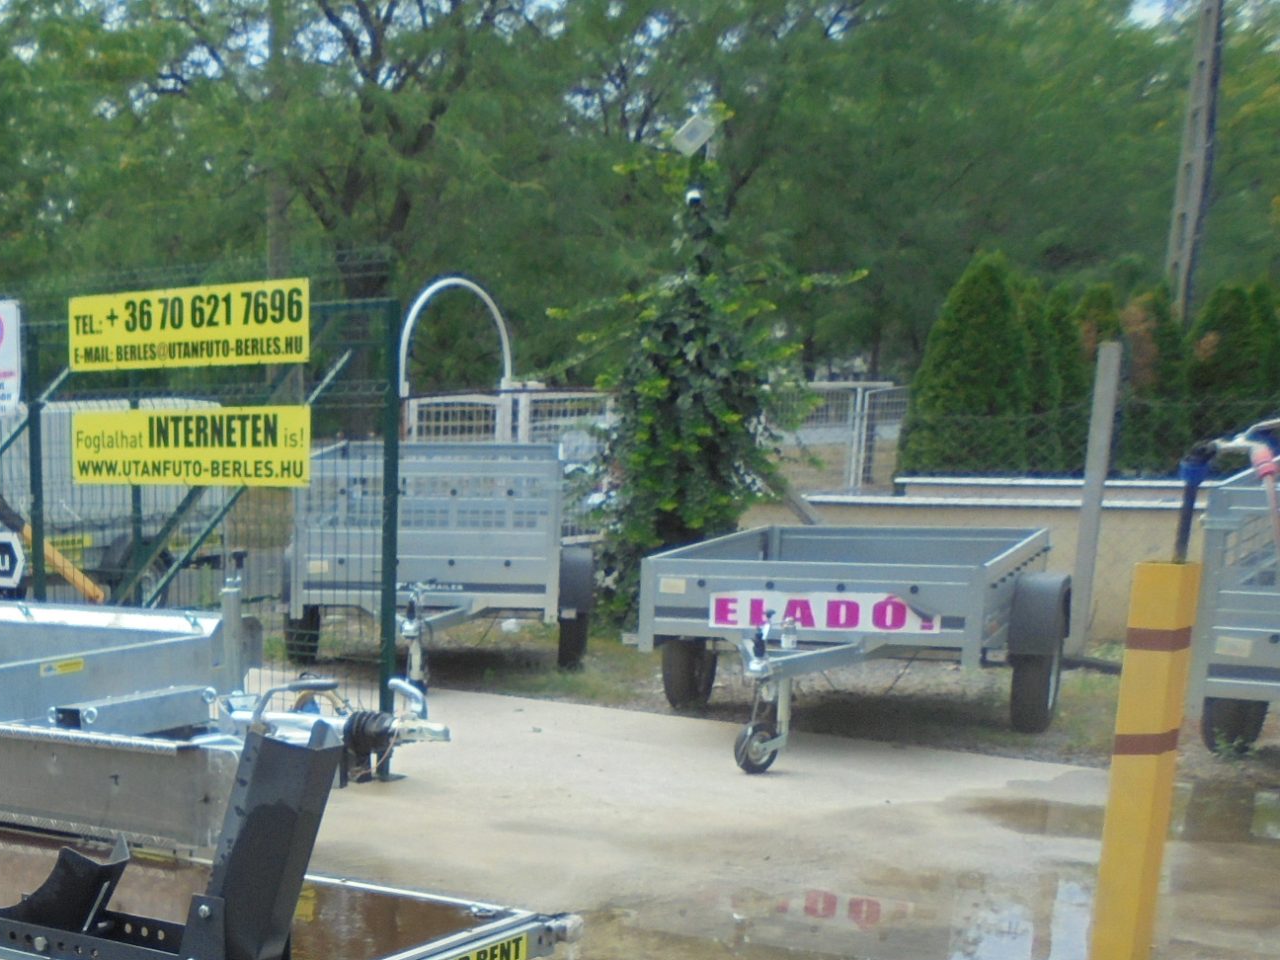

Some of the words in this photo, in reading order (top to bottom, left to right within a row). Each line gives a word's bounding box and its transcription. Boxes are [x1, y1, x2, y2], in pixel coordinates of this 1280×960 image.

[74, 315, 103, 336] TEL.:
[124, 299, 153, 333] 36
[158, 296, 184, 330] 70
[190, 292, 232, 327] 621
[241, 287, 303, 325] 7696
[74, 346, 114, 364] E-MAIL:
[116, 336, 303, 363] BERLES@UTANFUTO-BERLES.HU
[76, 430, 143, 454] Foglalhat
[148, 413, 278, 448] INTERNETEN
[284, 427, 304, 448] is!
[78, 459, 304, 479] WWW.UTANFUTO-BERLES.HU
